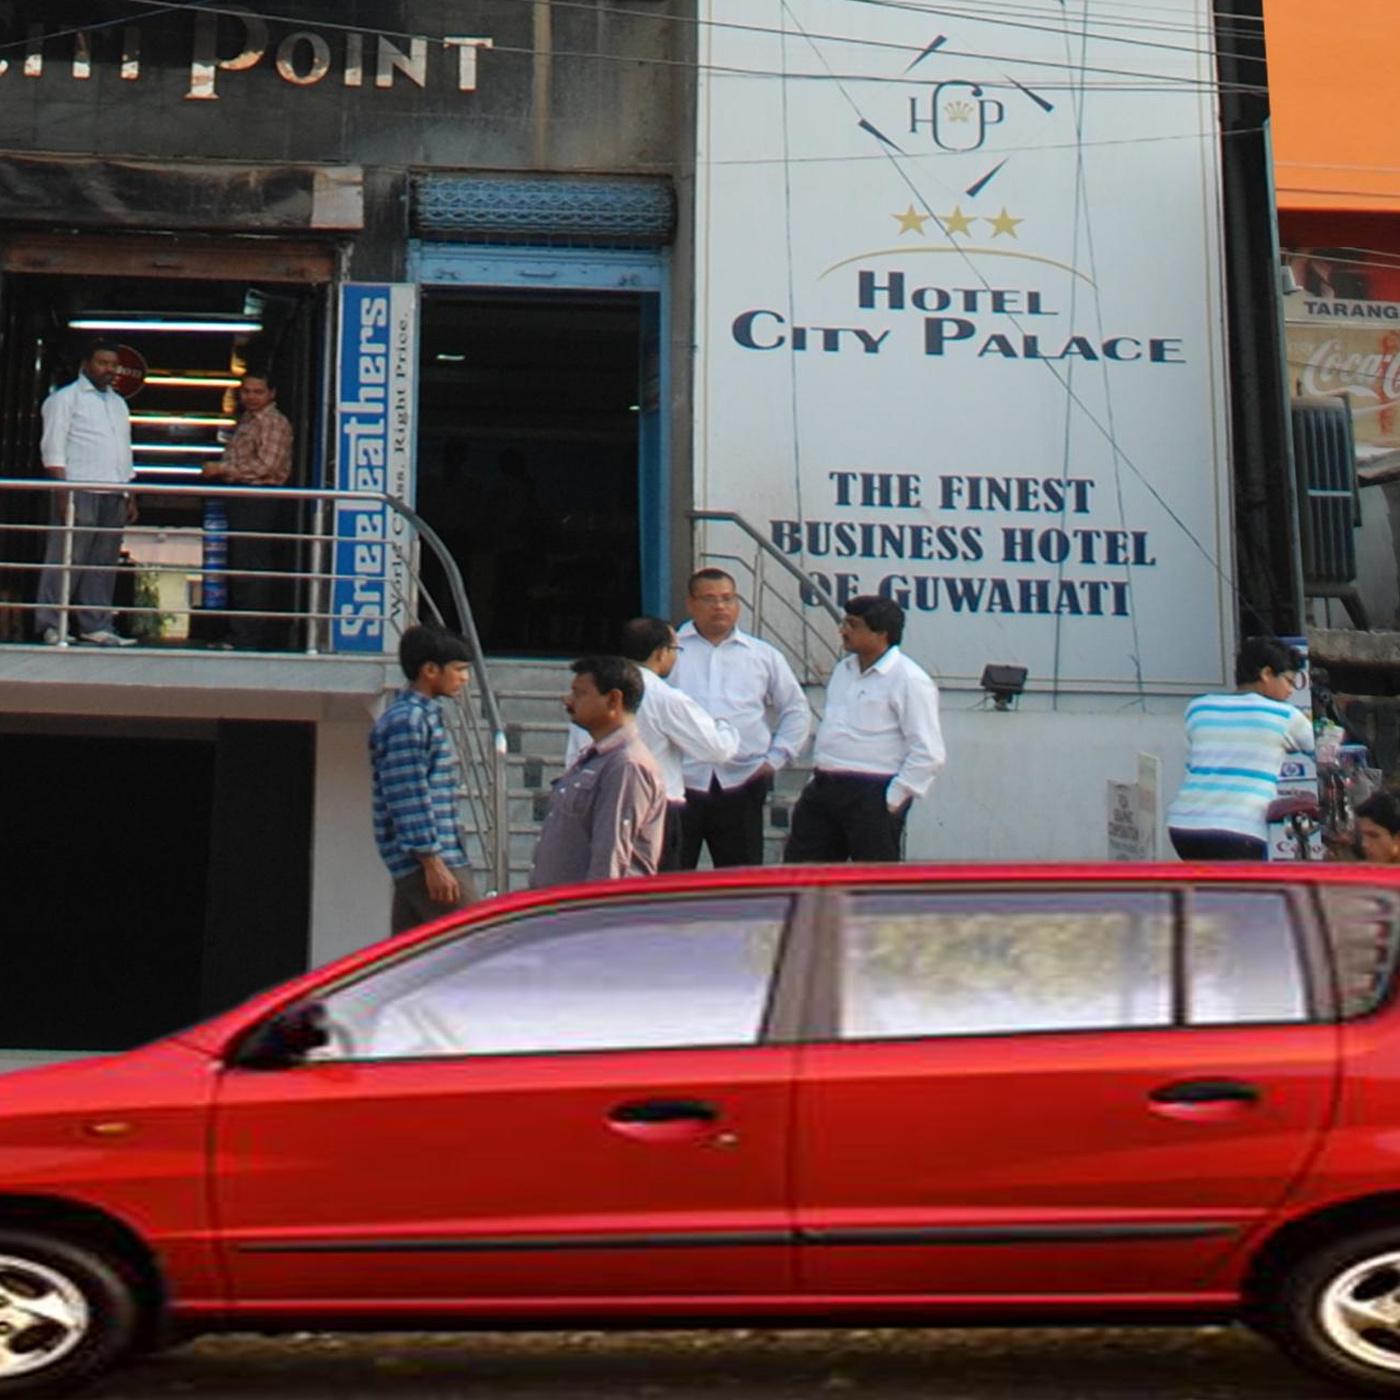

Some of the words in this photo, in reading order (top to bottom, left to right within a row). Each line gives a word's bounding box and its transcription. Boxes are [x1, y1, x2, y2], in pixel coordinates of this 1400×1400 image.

[184, 6, 494, 100] POINT
[858, 271, 1059, 316] HOTEL
[731, 309, 891, 355] CITY
[924, 317, 1187, 364] PALACE
[393, 389, 409, 454] Right
[829, 471, 922, 509] THE
[938, 475, 1096, 514] FINEST
[768, 519, 984, 562] BUSINESS
[1000, 527, 1157, 568] HOTEL
[799, 571, 860, 607] OF
[878, 575, 1130, 617] GUWAHATI
